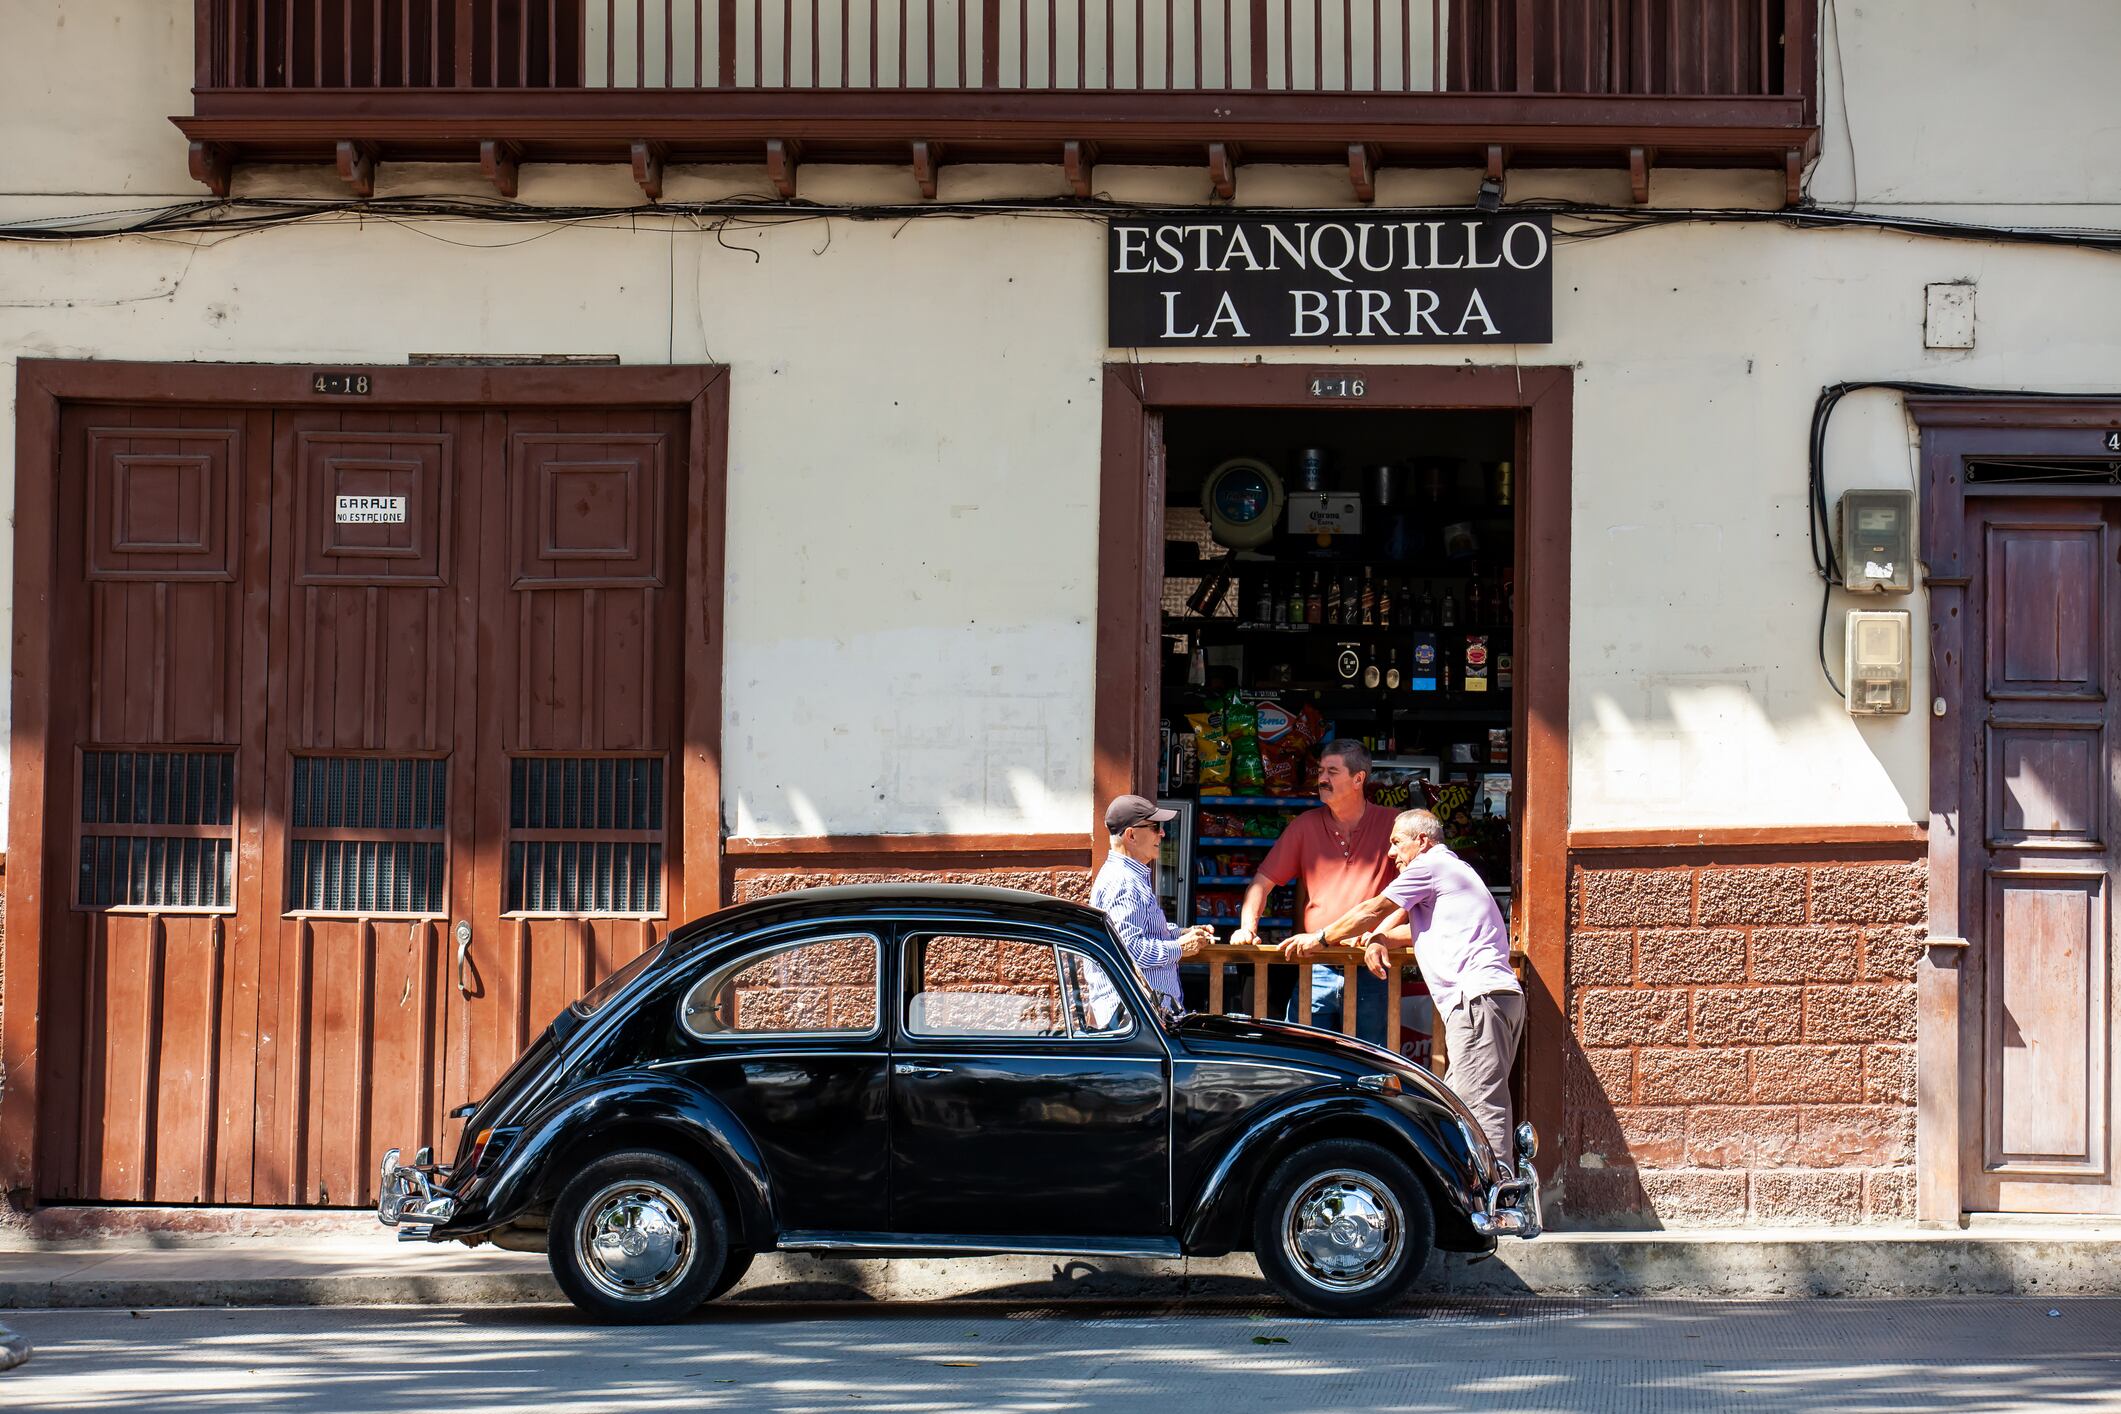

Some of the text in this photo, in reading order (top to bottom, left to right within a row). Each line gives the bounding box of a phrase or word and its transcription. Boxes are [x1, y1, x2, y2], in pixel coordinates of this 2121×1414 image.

[1113, 221, 1548, 283] ESTANQUILLO
[1159, 287, 1502, 339] LA BIRRA
[315, 375, 369, 394] 4-18
[1310, 378, 1365, 397] 4-16
[340, 498, 398, 509] GARAJE
[337, 513, 402, 522] NO ESTACIONE
[1309, 510, 1341, 521] Corona
[1257, 710, 1287, 729] Ramo
